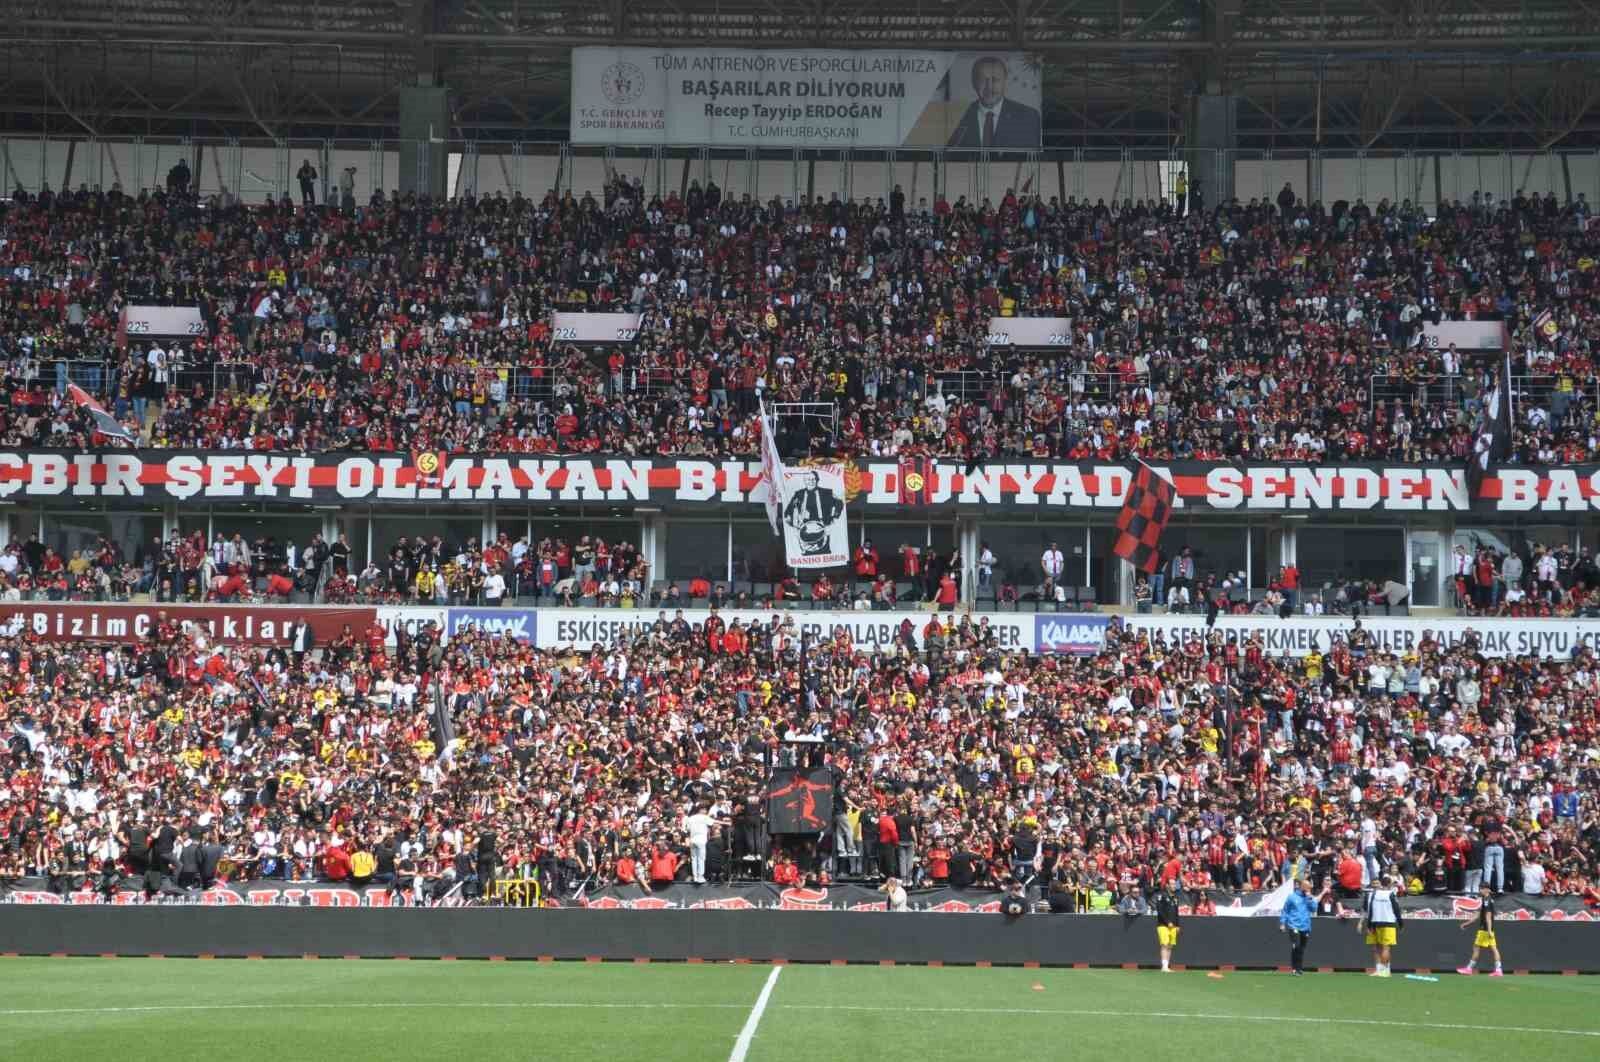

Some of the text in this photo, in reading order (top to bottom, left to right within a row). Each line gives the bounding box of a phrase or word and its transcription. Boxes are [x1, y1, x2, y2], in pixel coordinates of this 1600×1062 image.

[655, 54, 688, 71] TÜM
[691, 55, 776, 72] ANTRENÖR
[800, 56, 937, 74] SPORCULARIMIZA
[682, 77, 906, 100] BAŞARILAR DİLİYORUM
[704, 102, 883, 121] Recep Tayyip ERDOĞAN
[751, 126, 860, 141] CUMHURBAŞKANI
[127, 321, 150, 333] 225
[1206, 467, 1470, 511] SENDEN
[1518, 630, 1568, 653] SUYU
